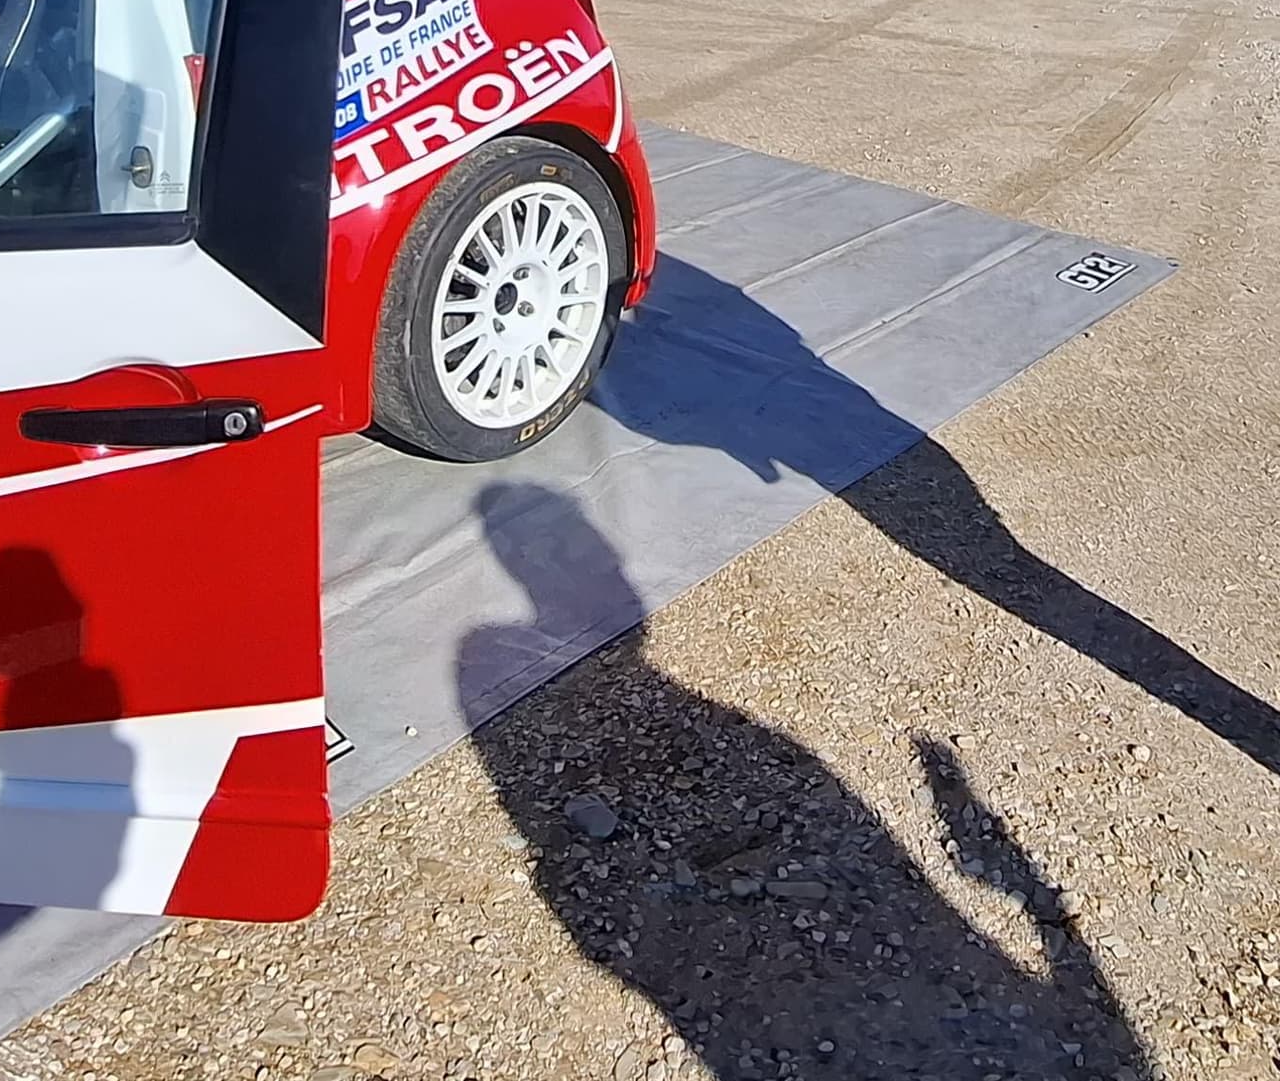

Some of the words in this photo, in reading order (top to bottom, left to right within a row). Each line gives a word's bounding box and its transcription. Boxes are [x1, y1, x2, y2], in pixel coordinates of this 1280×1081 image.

[366, 22, 486, 113] RALLYE
[380, 39, 404, 66] DE
[408, 0, 472, 50] FRANCE
[330, 29, 591, 194] TROËN
